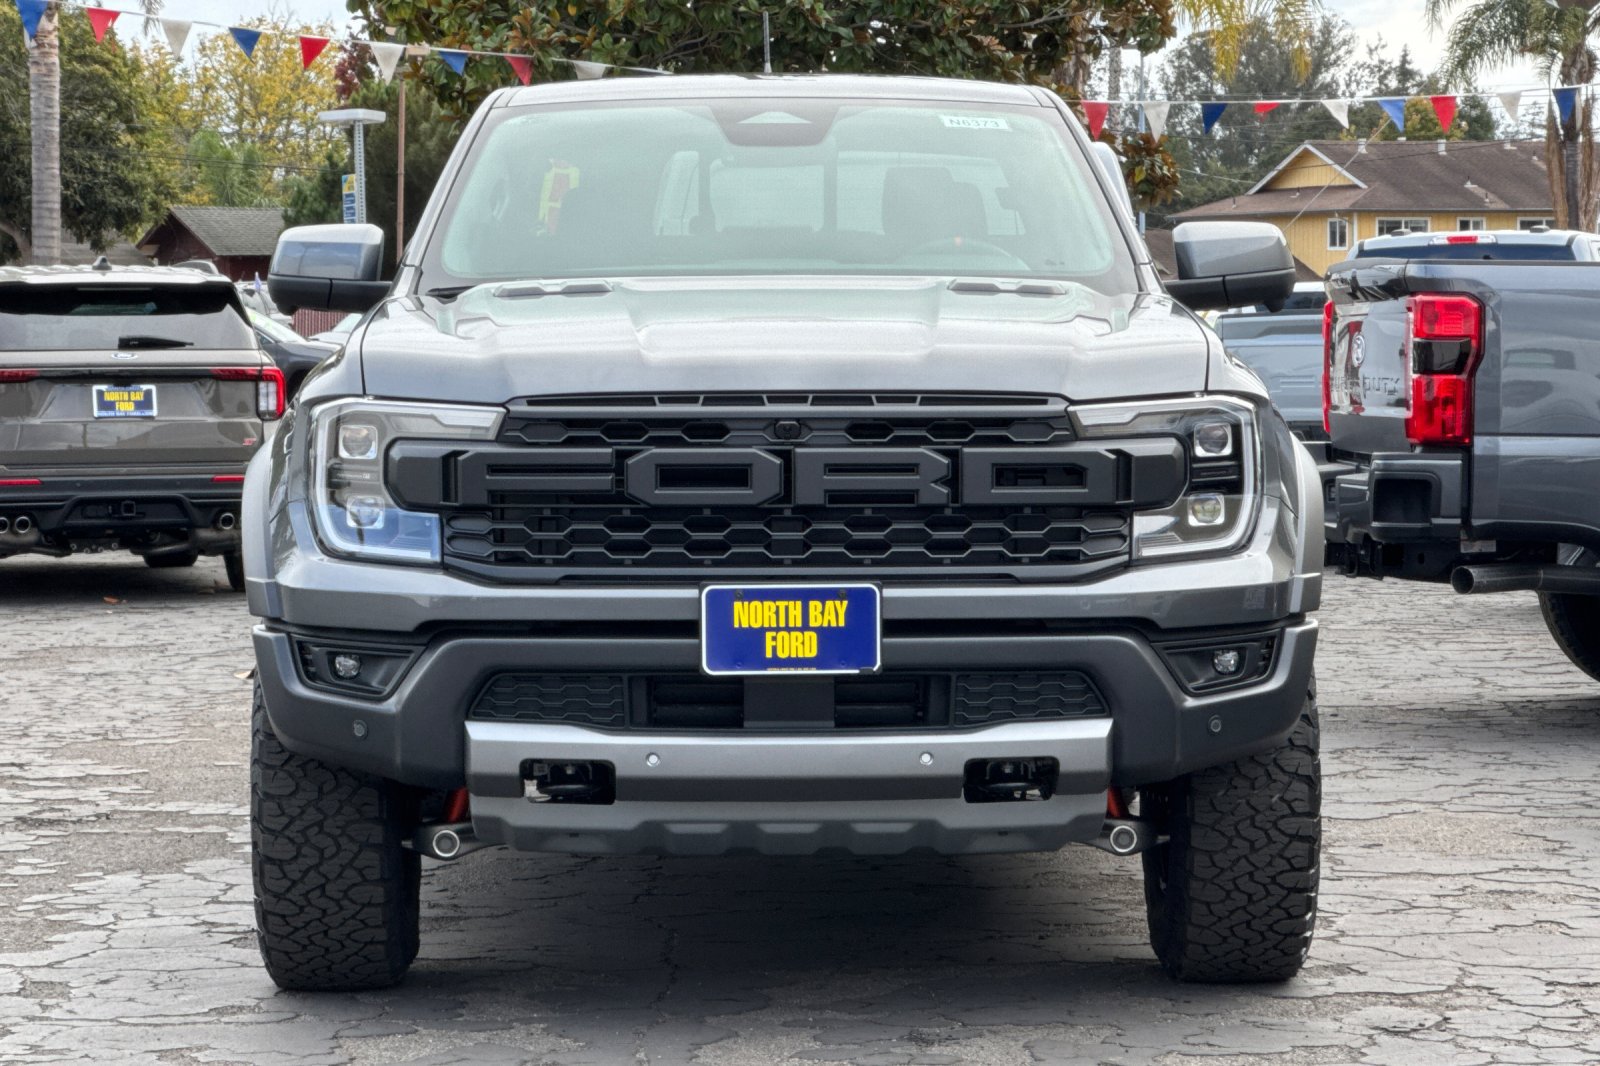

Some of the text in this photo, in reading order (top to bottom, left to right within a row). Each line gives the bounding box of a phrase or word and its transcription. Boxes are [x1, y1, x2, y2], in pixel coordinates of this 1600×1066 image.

[103, 391, 144, 401] NORTH BAY
[115, 401, 135, 411] FORD
[457, 446, 1116, 506] FORD
[733, 600, 848, 628] NORTH BAY
[765, 631, 818, 658] FORD
